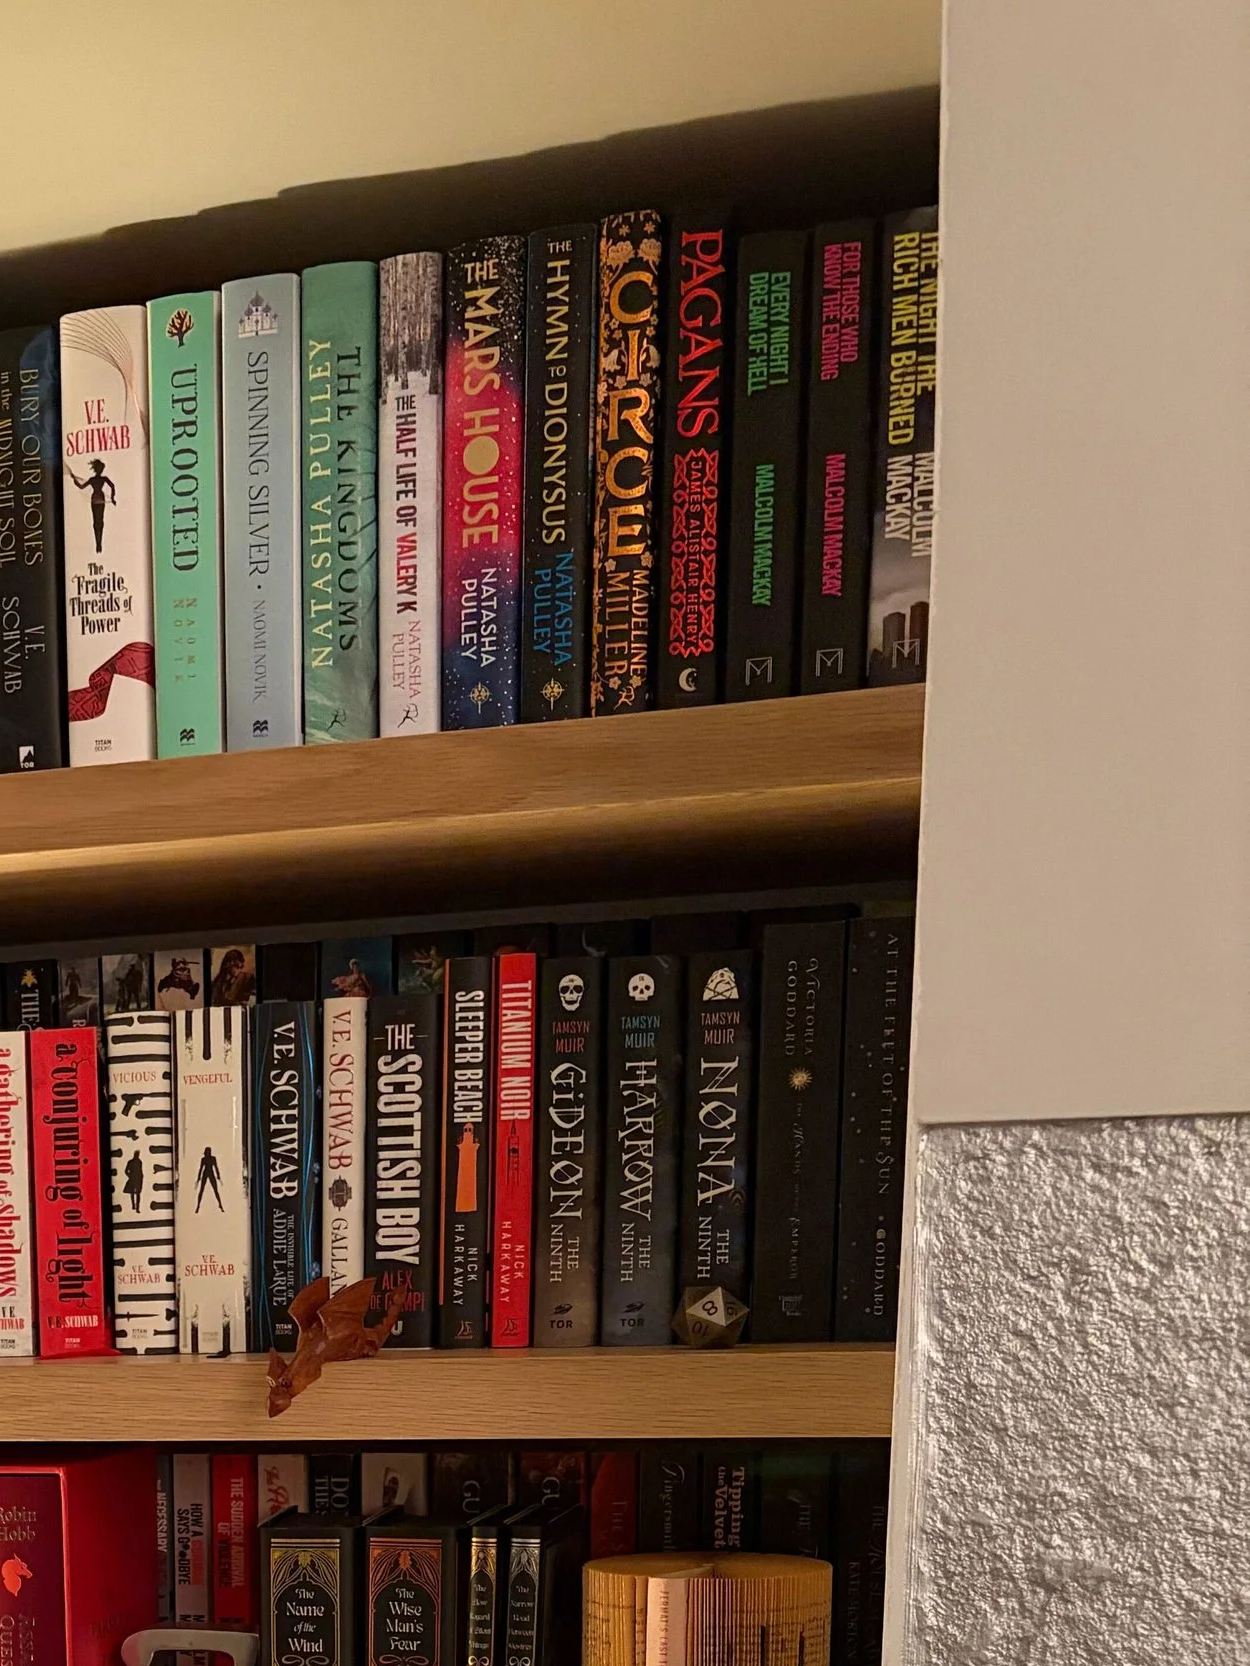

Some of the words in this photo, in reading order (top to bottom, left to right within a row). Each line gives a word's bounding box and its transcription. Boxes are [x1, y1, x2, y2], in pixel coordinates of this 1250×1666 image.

[465, 259, 499, 281] THE
[463, 287, 500, 396] MARS
[677, 229, 723, 438] PAGANS
[336, 346, 361, 421] THE
[395, 394, 416, 410] THE
[84, 399, 110, 425] V.E.
[247, 351, 270, 477] SPINNING
[309, 338, 331, 478] PULLEY
[606, 271, 655, 559] CIRCE
[66, 425, 130, 456] SCHWAB
[396, 412, 417, 456] HALF
[170, 364, 199, 572] UPROOTED
[396, 461, 417, 502] LIFE
[463, 409, 501, 550] HOUSE
[689, 461, 701, 514] JAMES
[396, 507, 417, 529] OF
[754, 464, 774, 542] MALCOLM
[248, 485, 271, 577] SILVER
[337, 439, 362, 651] KINGDOMS
[88, 563, 104, 575] The
[396, 534, 418, 598] VALERY
[686, 520, 701, 587] ALISTAIR
[752, 542, 773, 606] MACKAY
[71, 574, 128, 595] Fragile
[312, 497, 333, 668] NATASHA
[69, 596, 119, 617] Threads
[123, 596, 133, 615] of
[81, 614, 121, 635] Power
[396, 600, 417, 615] K
[605, 571, 629, 677] MILLER
[631, 569, 650, 676] MADELINE
[685, 593, 699, 647] HENRY
[273, 1021, 294, 1064] V.E.
[385, 1024, 416, 1049] THE
[455, 990, 484, 1064] SLEEPER
[501, 981, 532, 1068] TITANIUM
[551, 1020, 590, 1035] TAMSYN
[555, 1038, 584, 1053] MUIR
[55, 1043, 76, 1056] a
[112, 1071, 156, 1085] VICIOUS
[183, 1074, 232, 1085] VENGEFUL
[454, 1068, 482, 1123] BEACH
[500, 1071, 532, 1121] NOIR
[44, 1062, 87, 1201] conjuring
[269, 1071, 299, 1199] SCHWAB
[376, 1054, 423, 1200] SCOTTISH
[698, 1056, 738, 1207] NONA
[64, 1205, 89, 1230] of
[375, 1208, 420, 1264] BOY
[46, 1231, 94, 1308] light
[185, 1263, 235, 1276] SCHWAB
[551, 1224, 562, 1283] NINTH
[566, 1236, 579, 1270] THE
[550, 1319, 573, 1330] TOR
[702, 1300, 718, 1316] 8
[717, 1466, 727, 1485] the
[714, 1486, 728, 1549] Velvet
[728, 1466, 745, 1547] Tipping
[286, 1602, 324, 1617] Name
[295, 1588, 314, 1599] The
[389, 1601, 422, 1617] Wise
[396, 1588, 414, 1599] The
[289, 1639, 323, 1653] Wind
[294, 1622, 304, 1633] of
[304, 1622, 316, 1633] the
[386, 1619, 423, 1633] Man's
[389, 1636, 420, 1651] Fear
